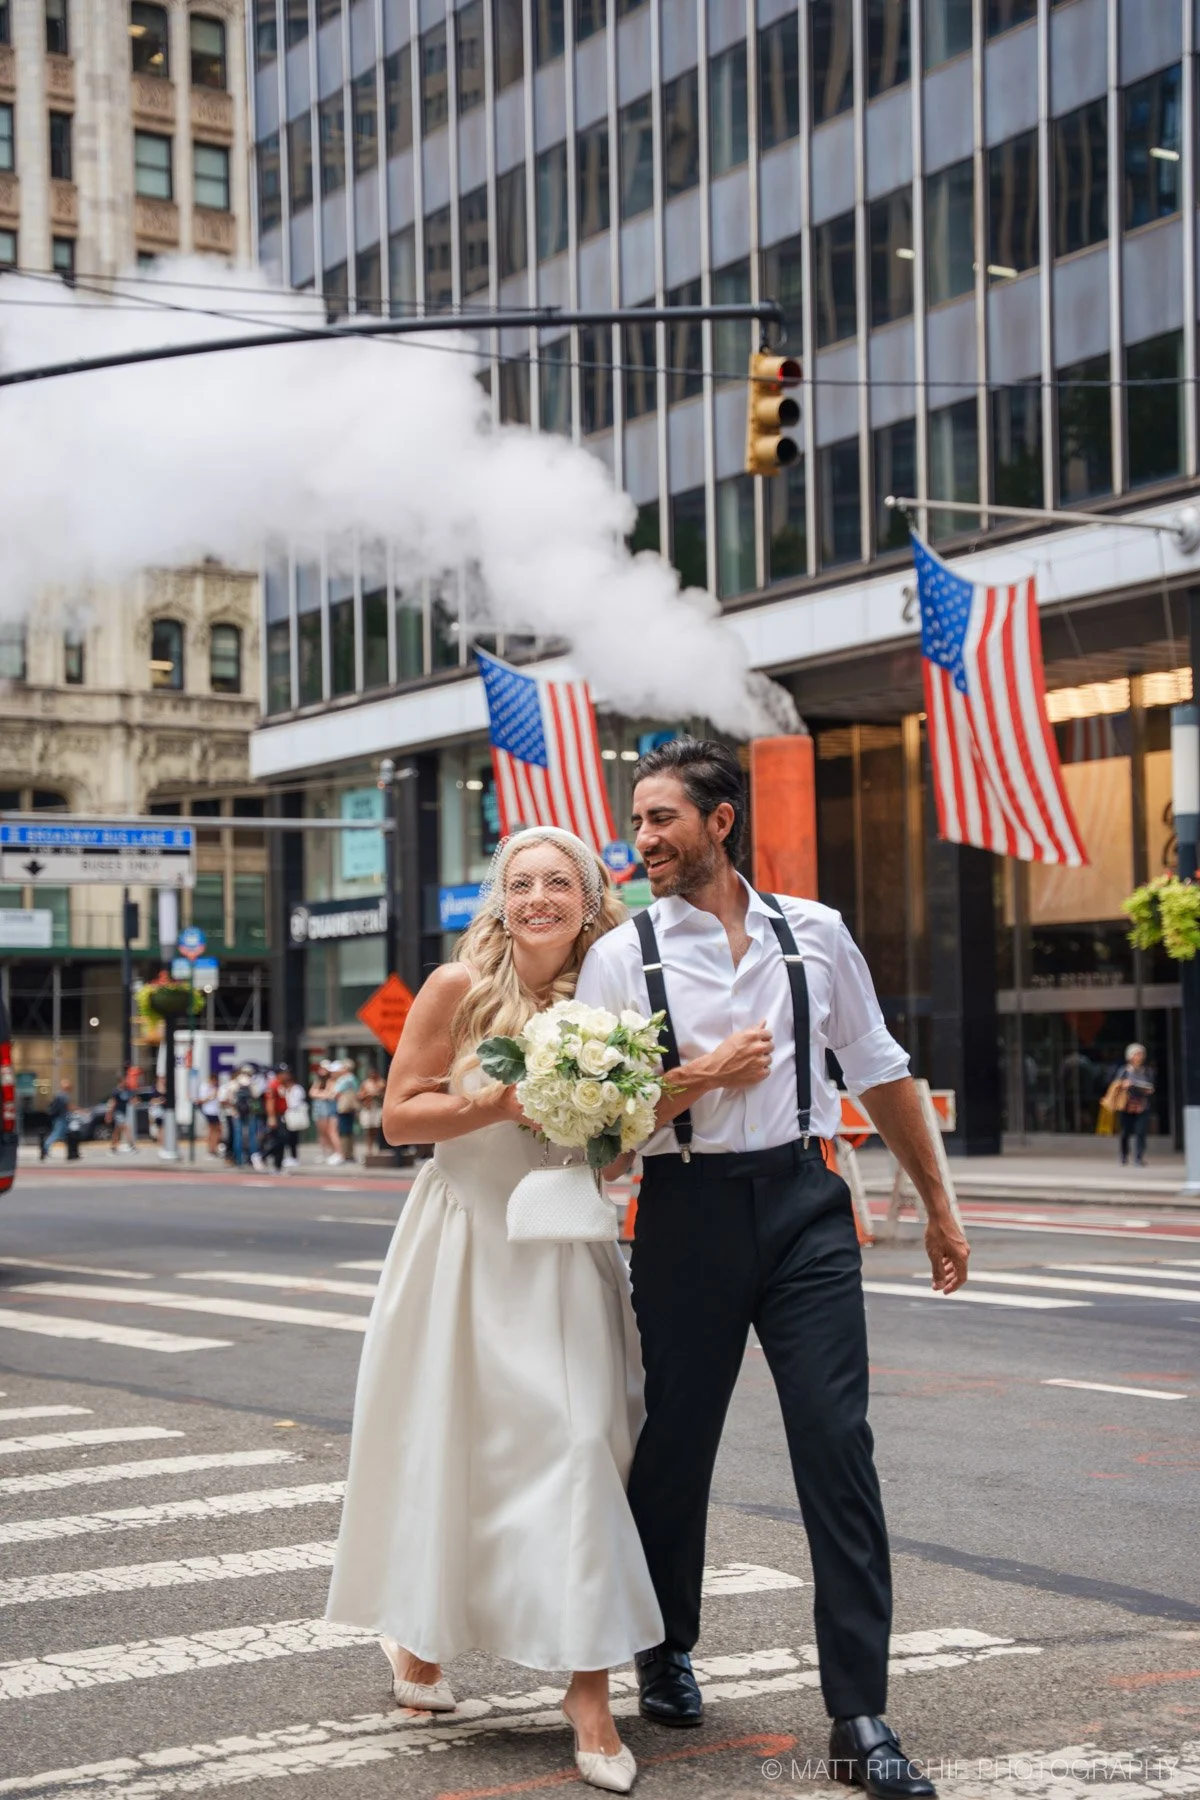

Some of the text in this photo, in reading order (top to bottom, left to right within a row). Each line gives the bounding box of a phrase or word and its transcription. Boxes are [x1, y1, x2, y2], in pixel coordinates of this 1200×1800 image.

[26, 830, 166, 845] BROADWAY BUS LANE
